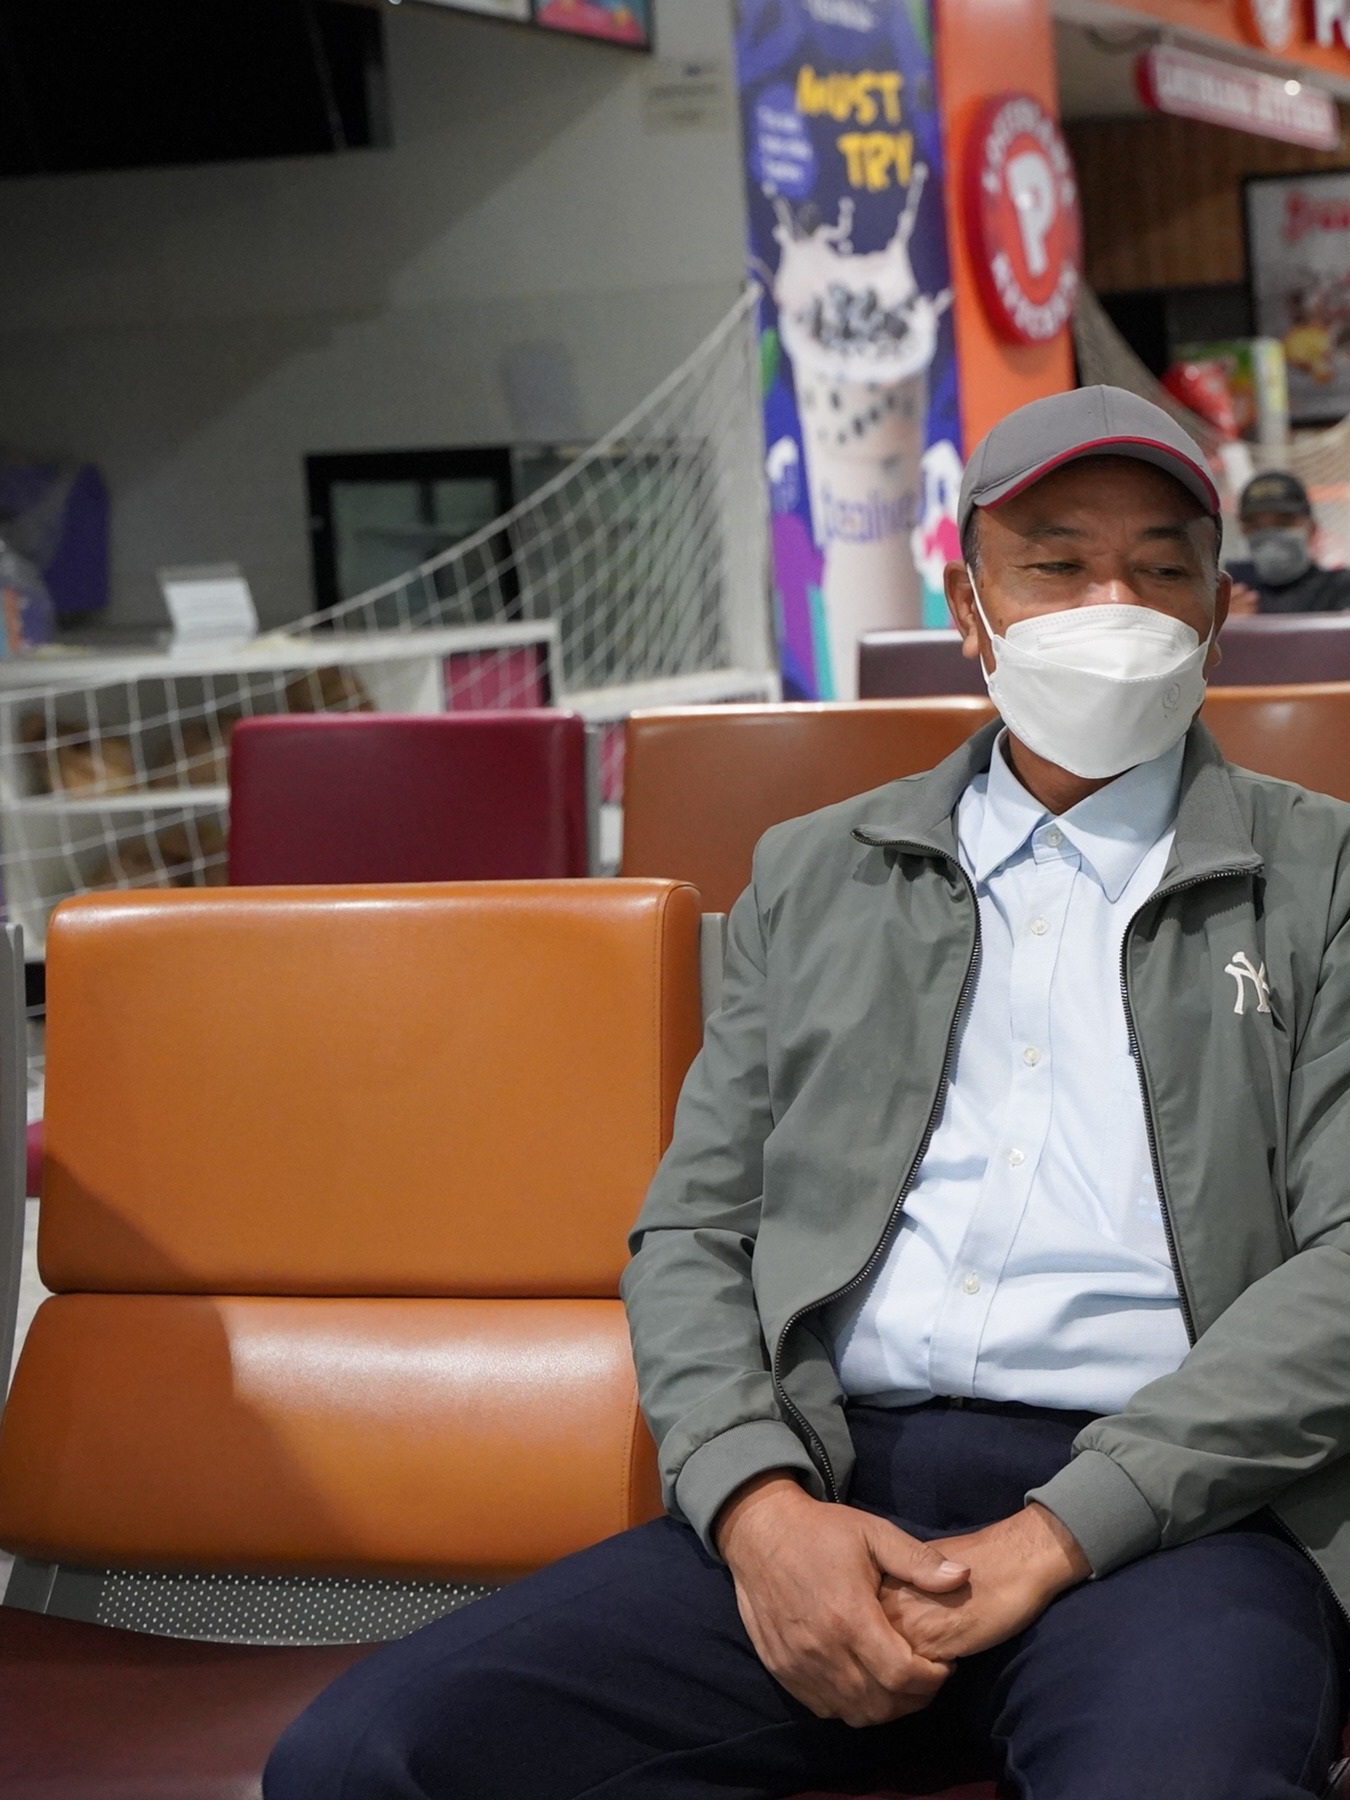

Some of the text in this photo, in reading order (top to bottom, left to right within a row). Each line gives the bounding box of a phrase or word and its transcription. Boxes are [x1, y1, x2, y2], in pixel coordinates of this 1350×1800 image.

[796, 66, 902, 124] MUST
[838, 131, 913, 191] TRY
[1006, 152, 1056, 276] P
